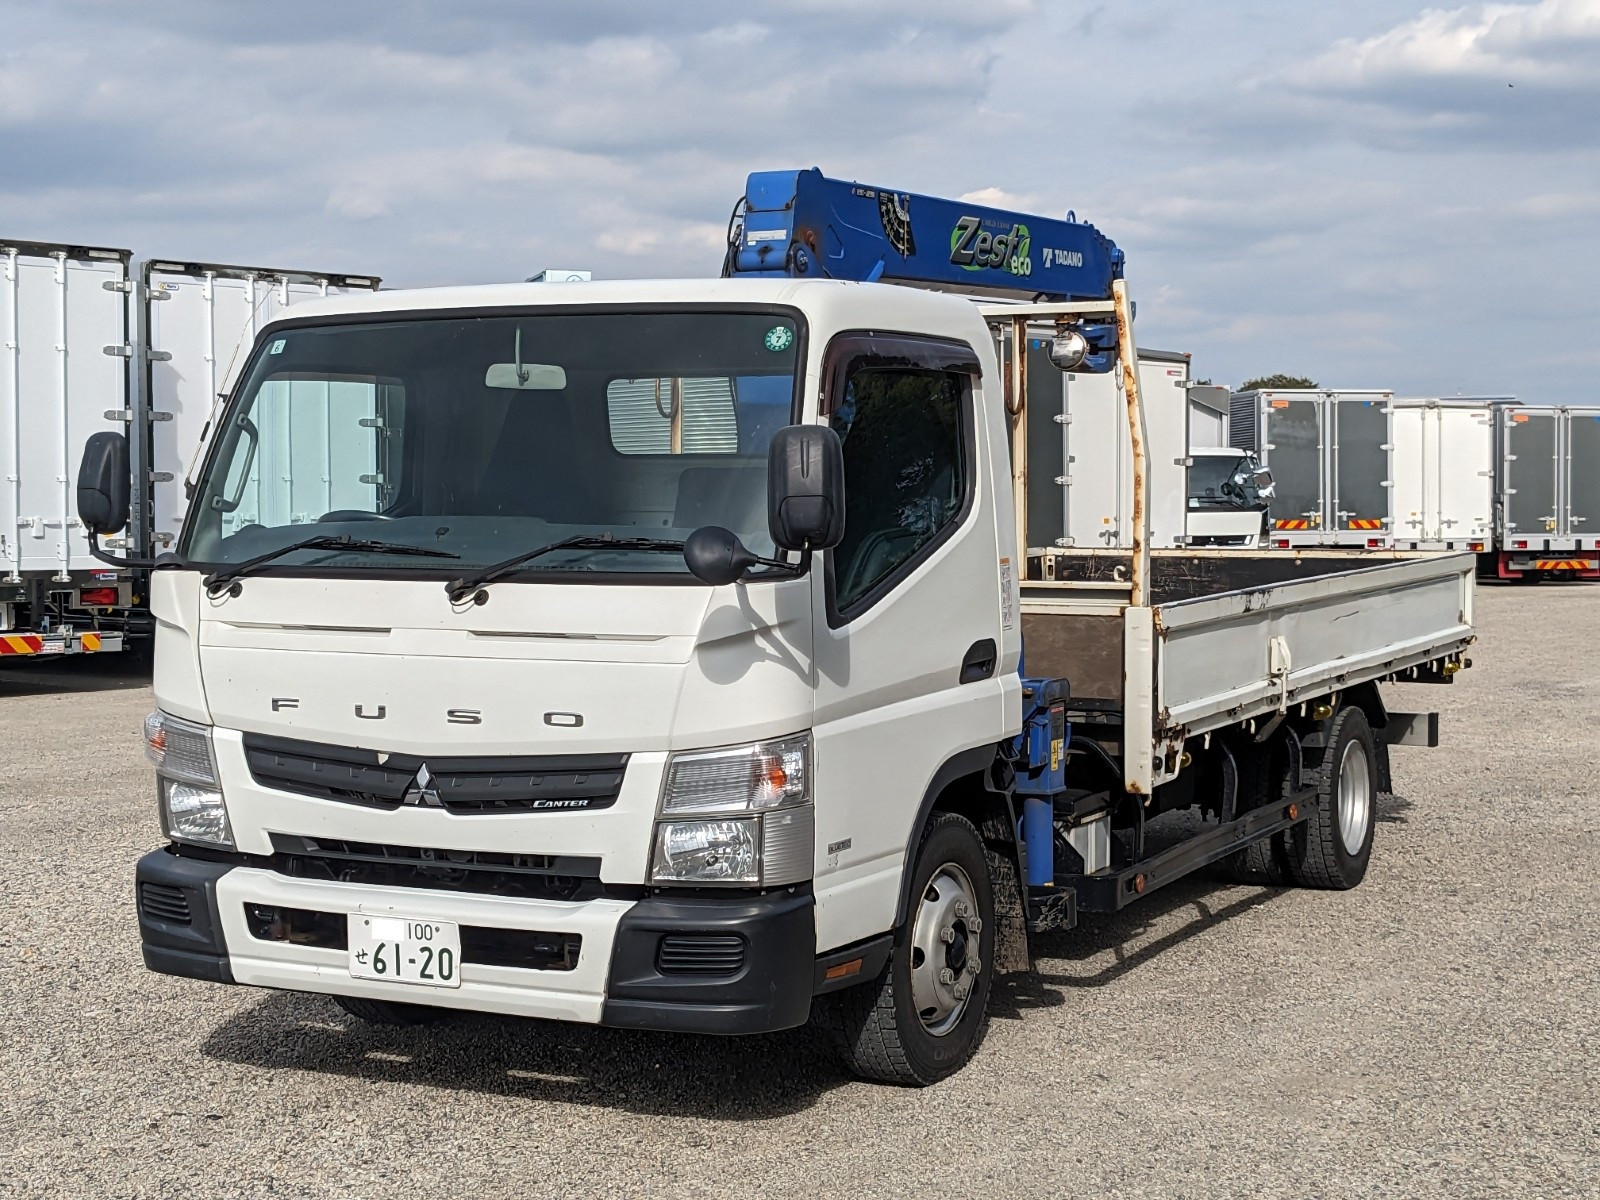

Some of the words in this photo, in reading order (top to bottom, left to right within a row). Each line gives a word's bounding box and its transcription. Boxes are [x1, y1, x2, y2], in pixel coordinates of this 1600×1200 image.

[950, 215, 1020, 268] Zest
[1011, 254, 1031, 276] eco
[1054, 249, 1083, 268] TADANO
[775, 336, 782, 344] 7
[271, 696, 584, 728] FUSO
[532, 799, 589, 809] CANTER
[408, 922, 433, 941] 100
[355, 948, 369, 965] せ
[373, 942, 453, 981] 61-20
